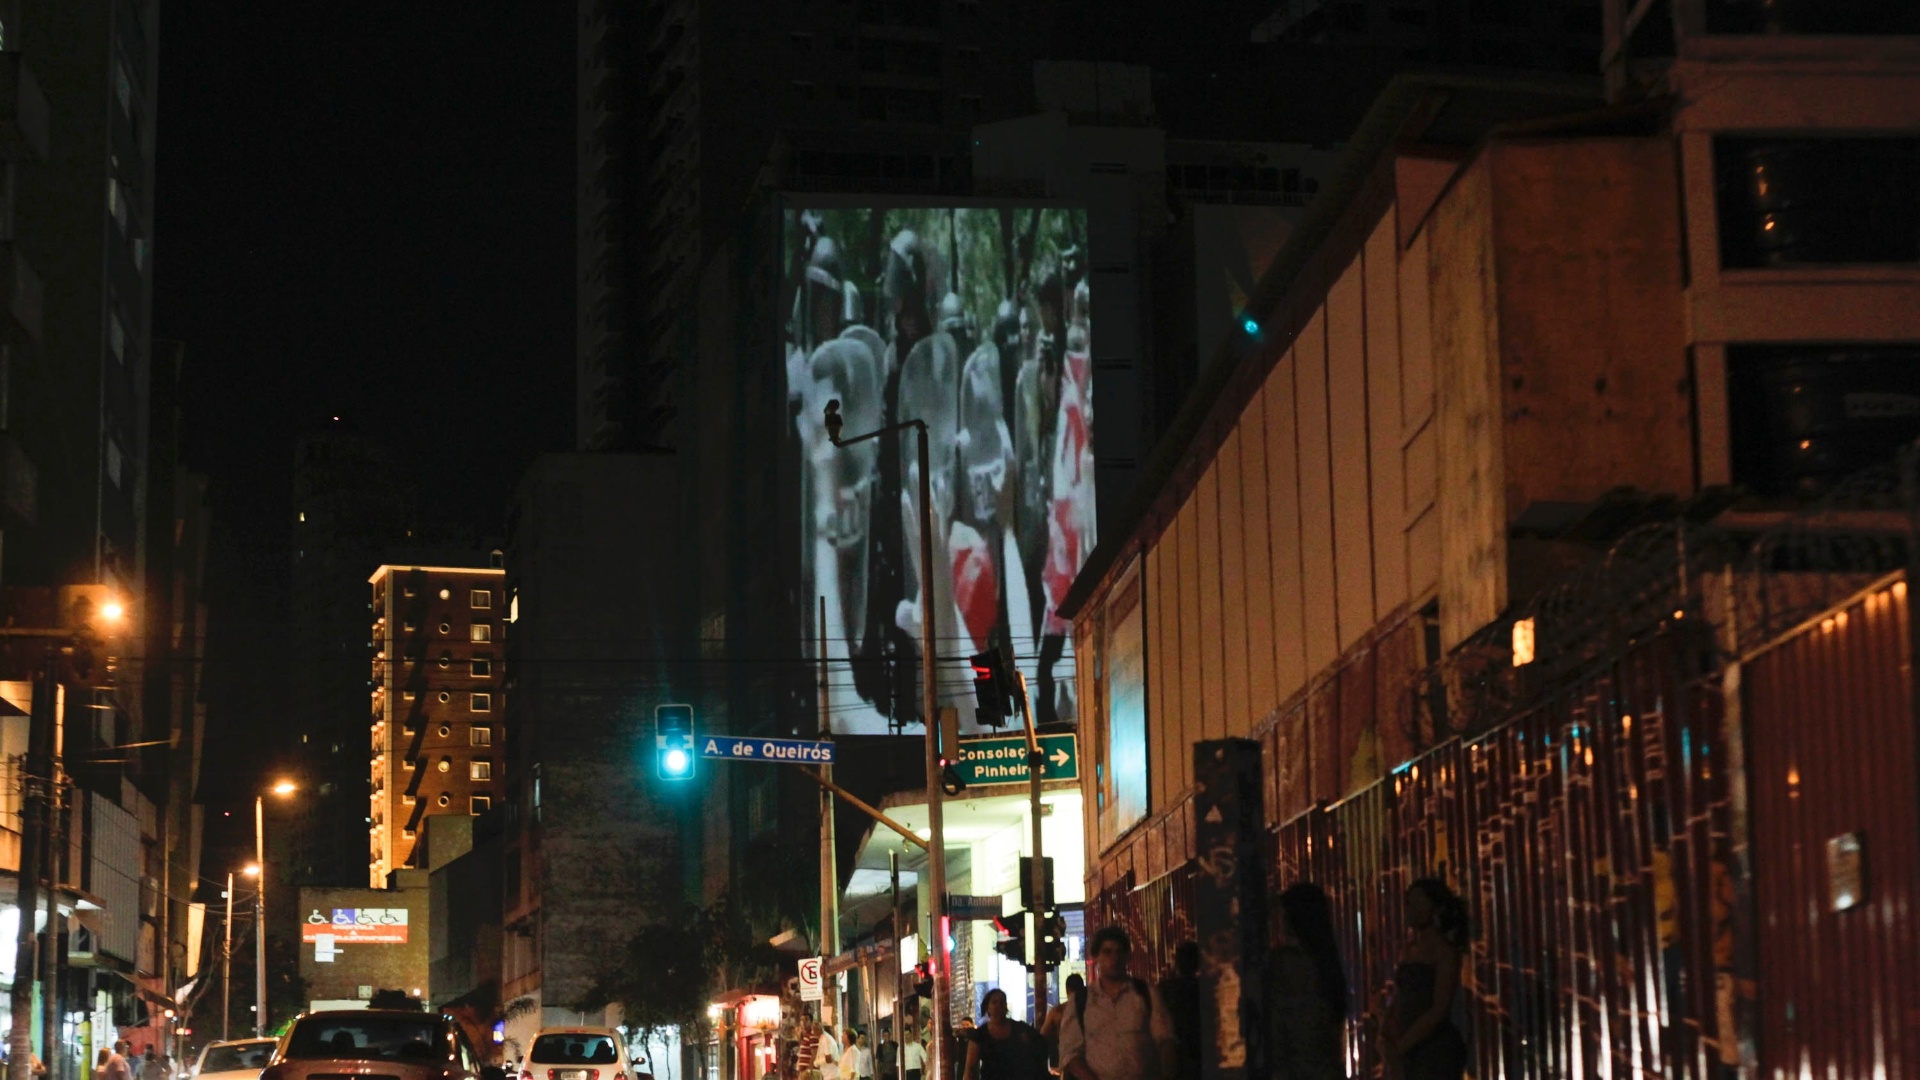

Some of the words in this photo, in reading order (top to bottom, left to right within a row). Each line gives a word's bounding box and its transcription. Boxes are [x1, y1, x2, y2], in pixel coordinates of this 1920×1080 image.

[704, 739, 723, 755] A.
[732, 741, 753, 756] de
[762, 742, 832, 760] Queirós
[974, 763, 1046, 778] Pinheirs
